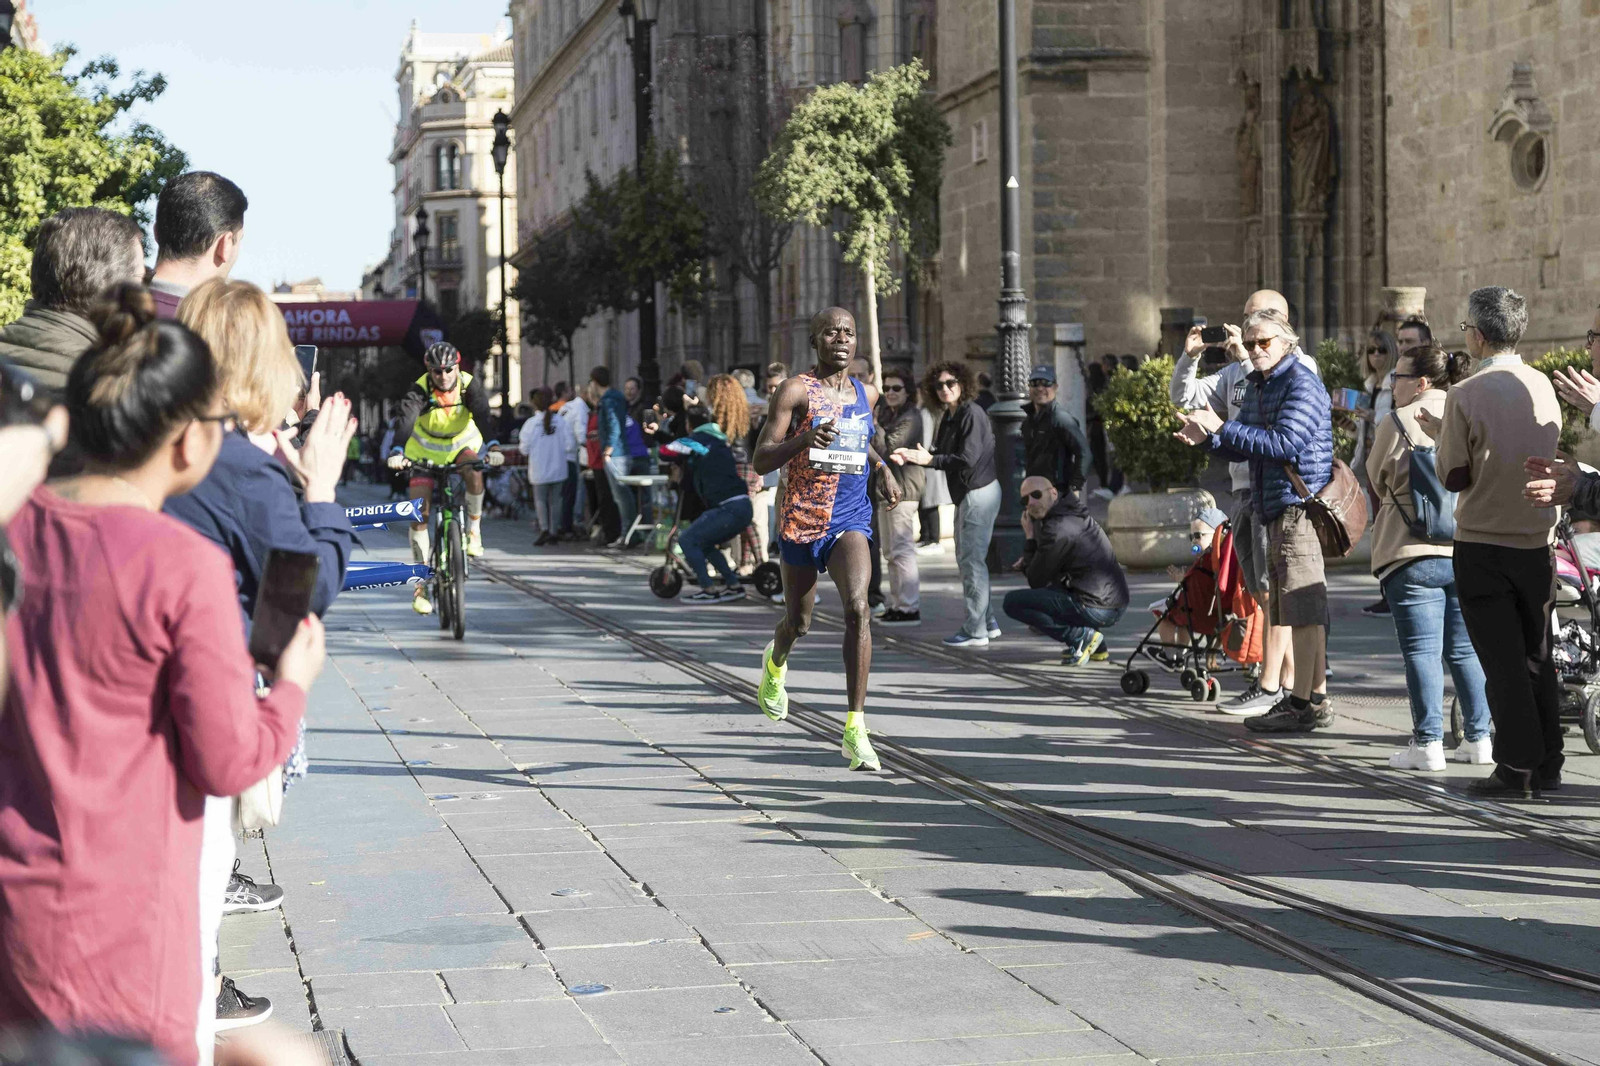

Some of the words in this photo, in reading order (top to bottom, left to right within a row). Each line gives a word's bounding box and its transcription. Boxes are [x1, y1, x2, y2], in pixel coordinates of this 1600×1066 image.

[284, 309, 352, 326] AHORA
[289, 326, 307, 341] TE
[312, 325, 380, 341] RINDAS
[828, 453, 852, 461] KIPTUM
[345, 504, 393, 517] ZURICH
